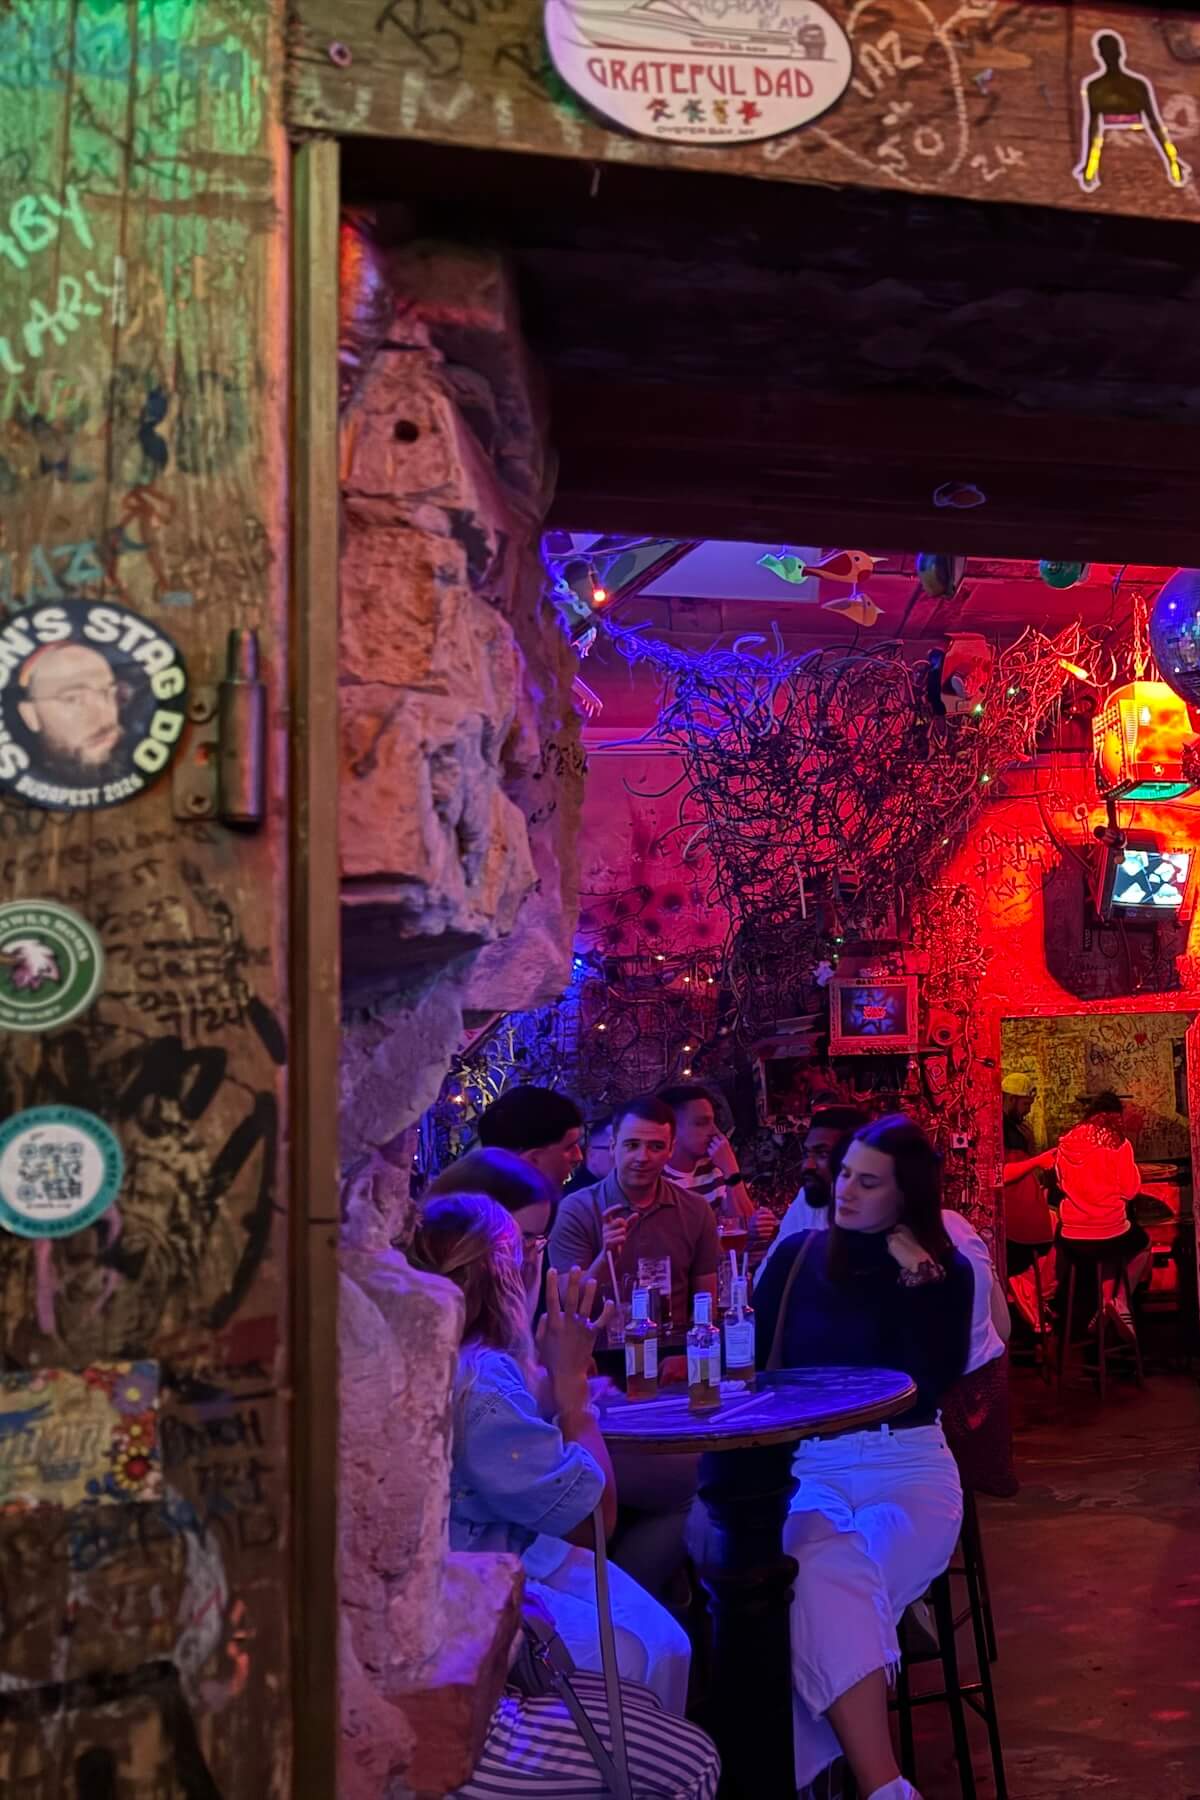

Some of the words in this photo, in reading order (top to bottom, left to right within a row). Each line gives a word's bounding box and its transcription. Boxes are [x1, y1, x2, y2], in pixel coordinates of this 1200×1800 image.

[586, 57, 746, 97] GRATEFUL
[754, 65, 814, 98] DAD
[83, 606, 186, 700] STAG
[132, 709, 185, 773] DO
